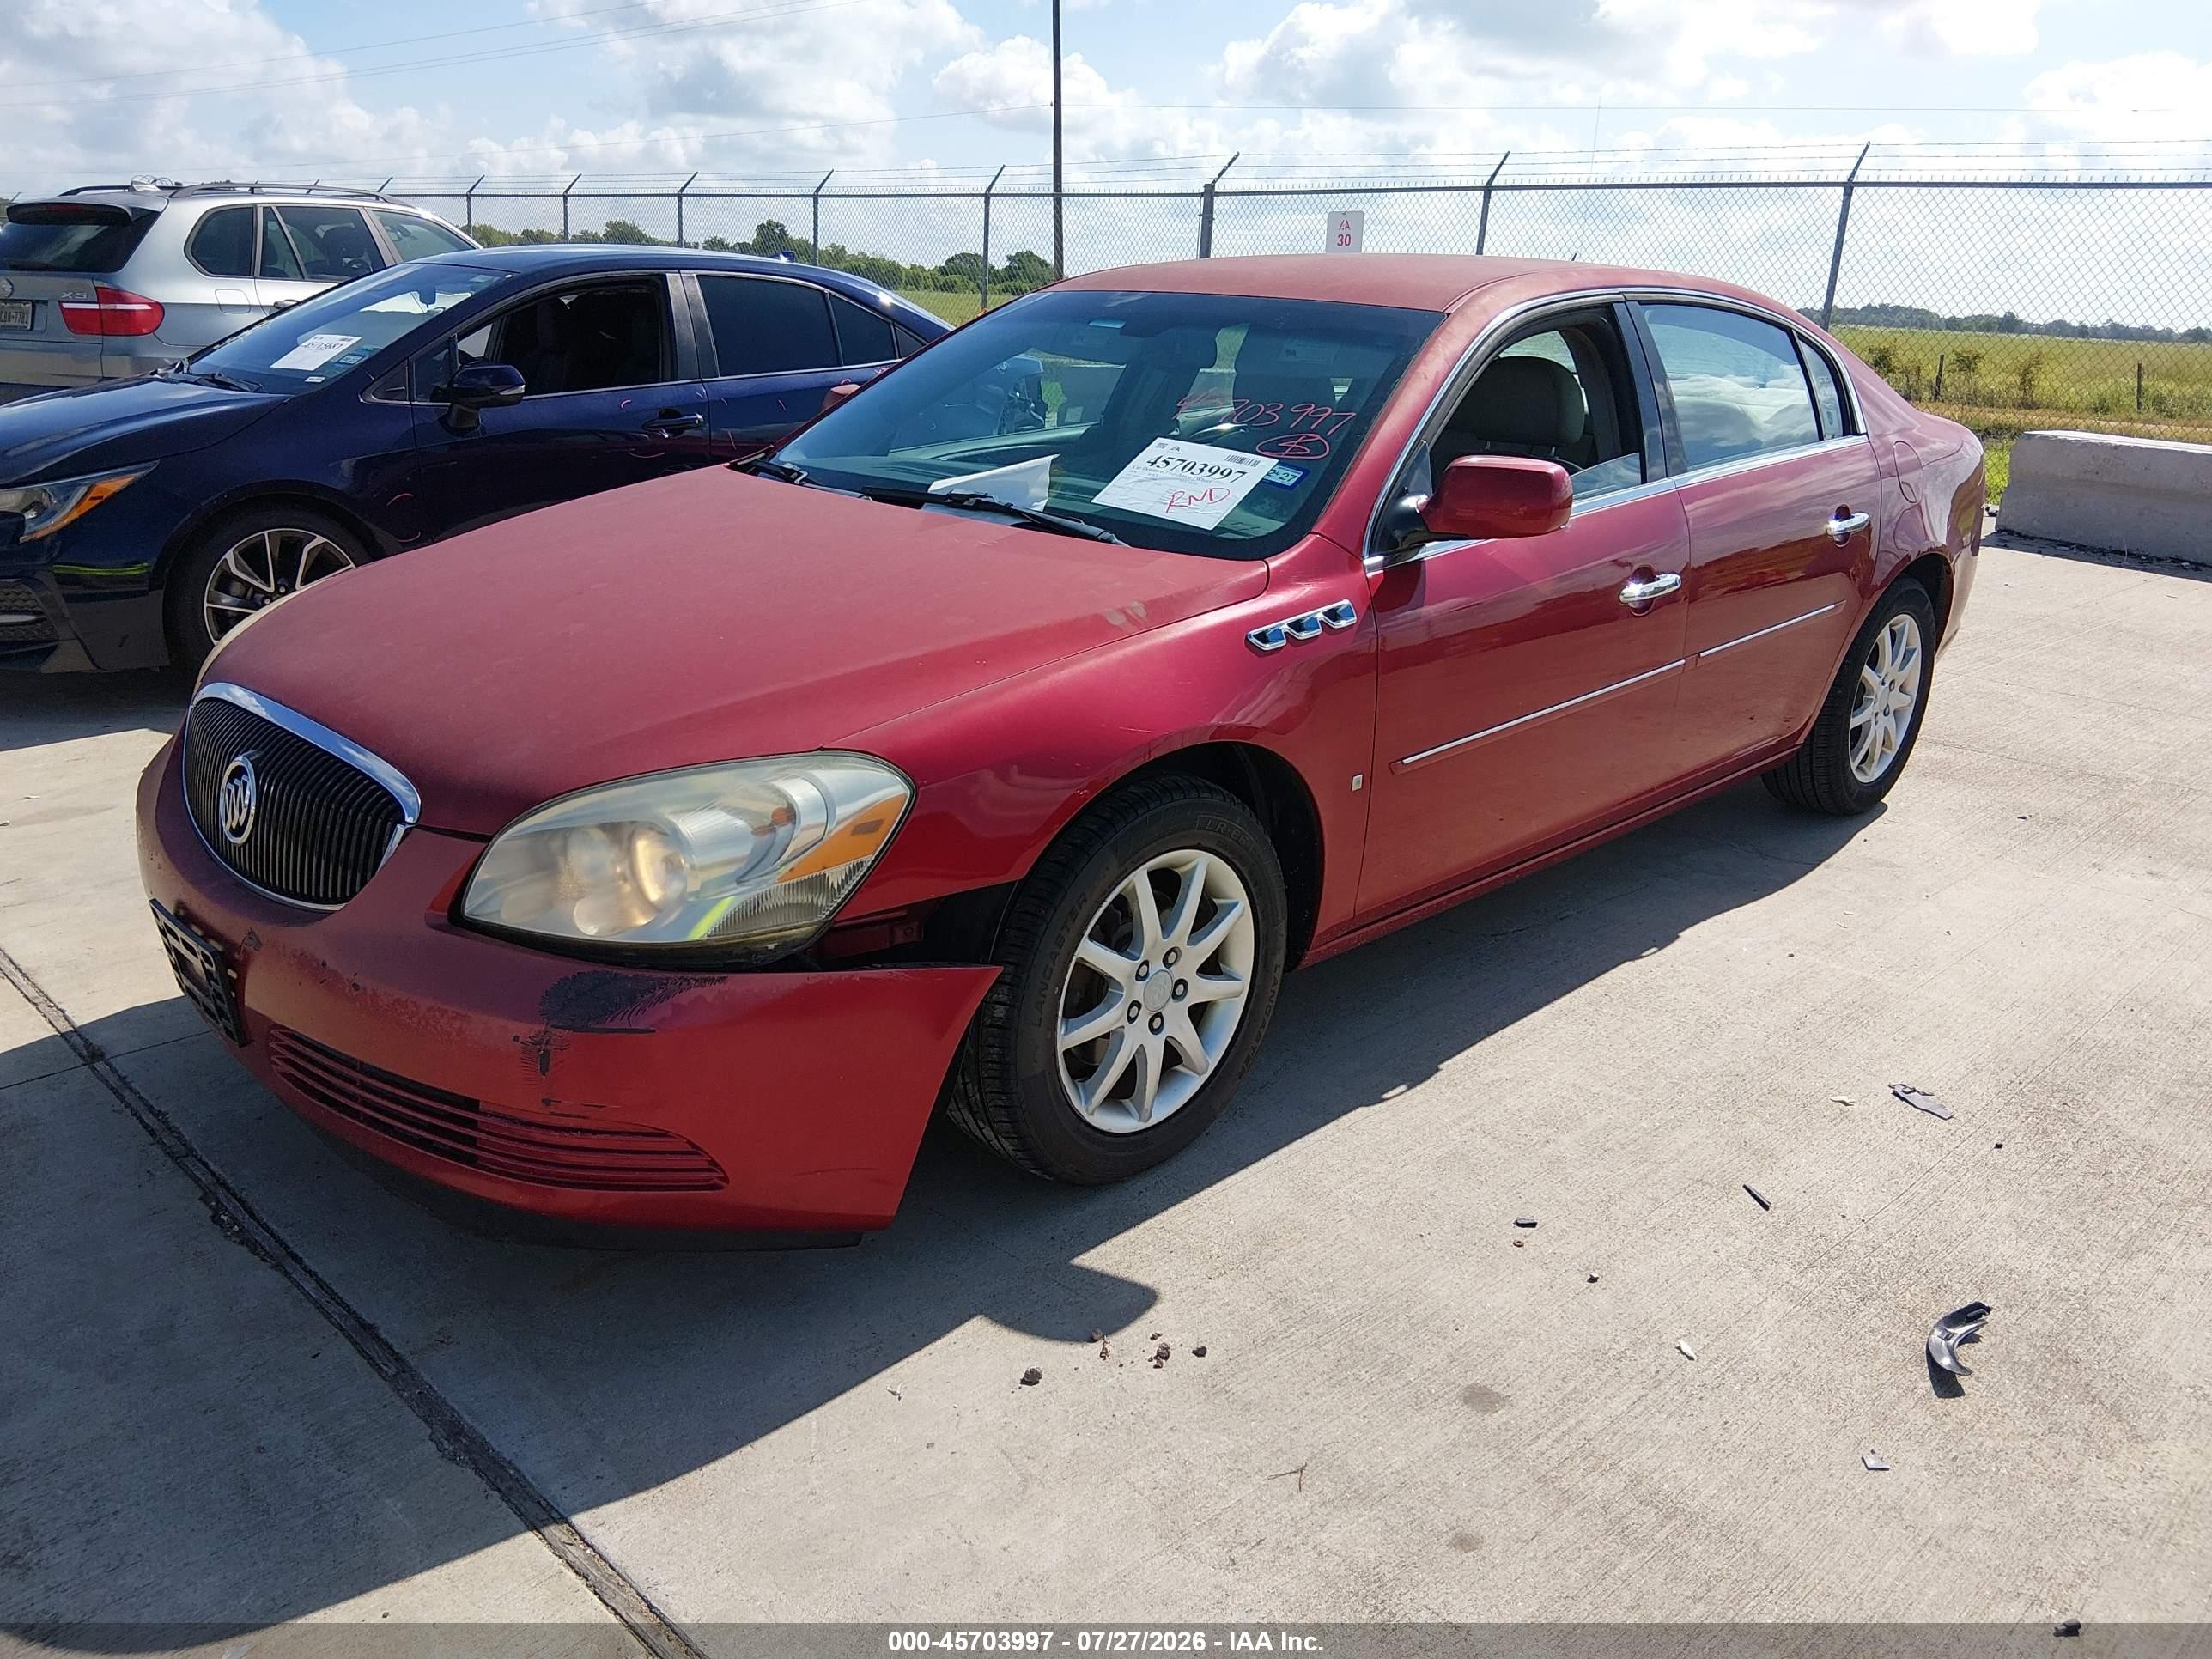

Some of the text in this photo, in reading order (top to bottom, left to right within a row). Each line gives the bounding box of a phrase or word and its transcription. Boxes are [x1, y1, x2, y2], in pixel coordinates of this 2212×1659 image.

[1337, 234, 1352, 247] 30
[1146, 454, 1249, 483] 45703997
[1166, 487, 1231, 514] RND
[1030, 892, 1088, 1028] LANCASTER
